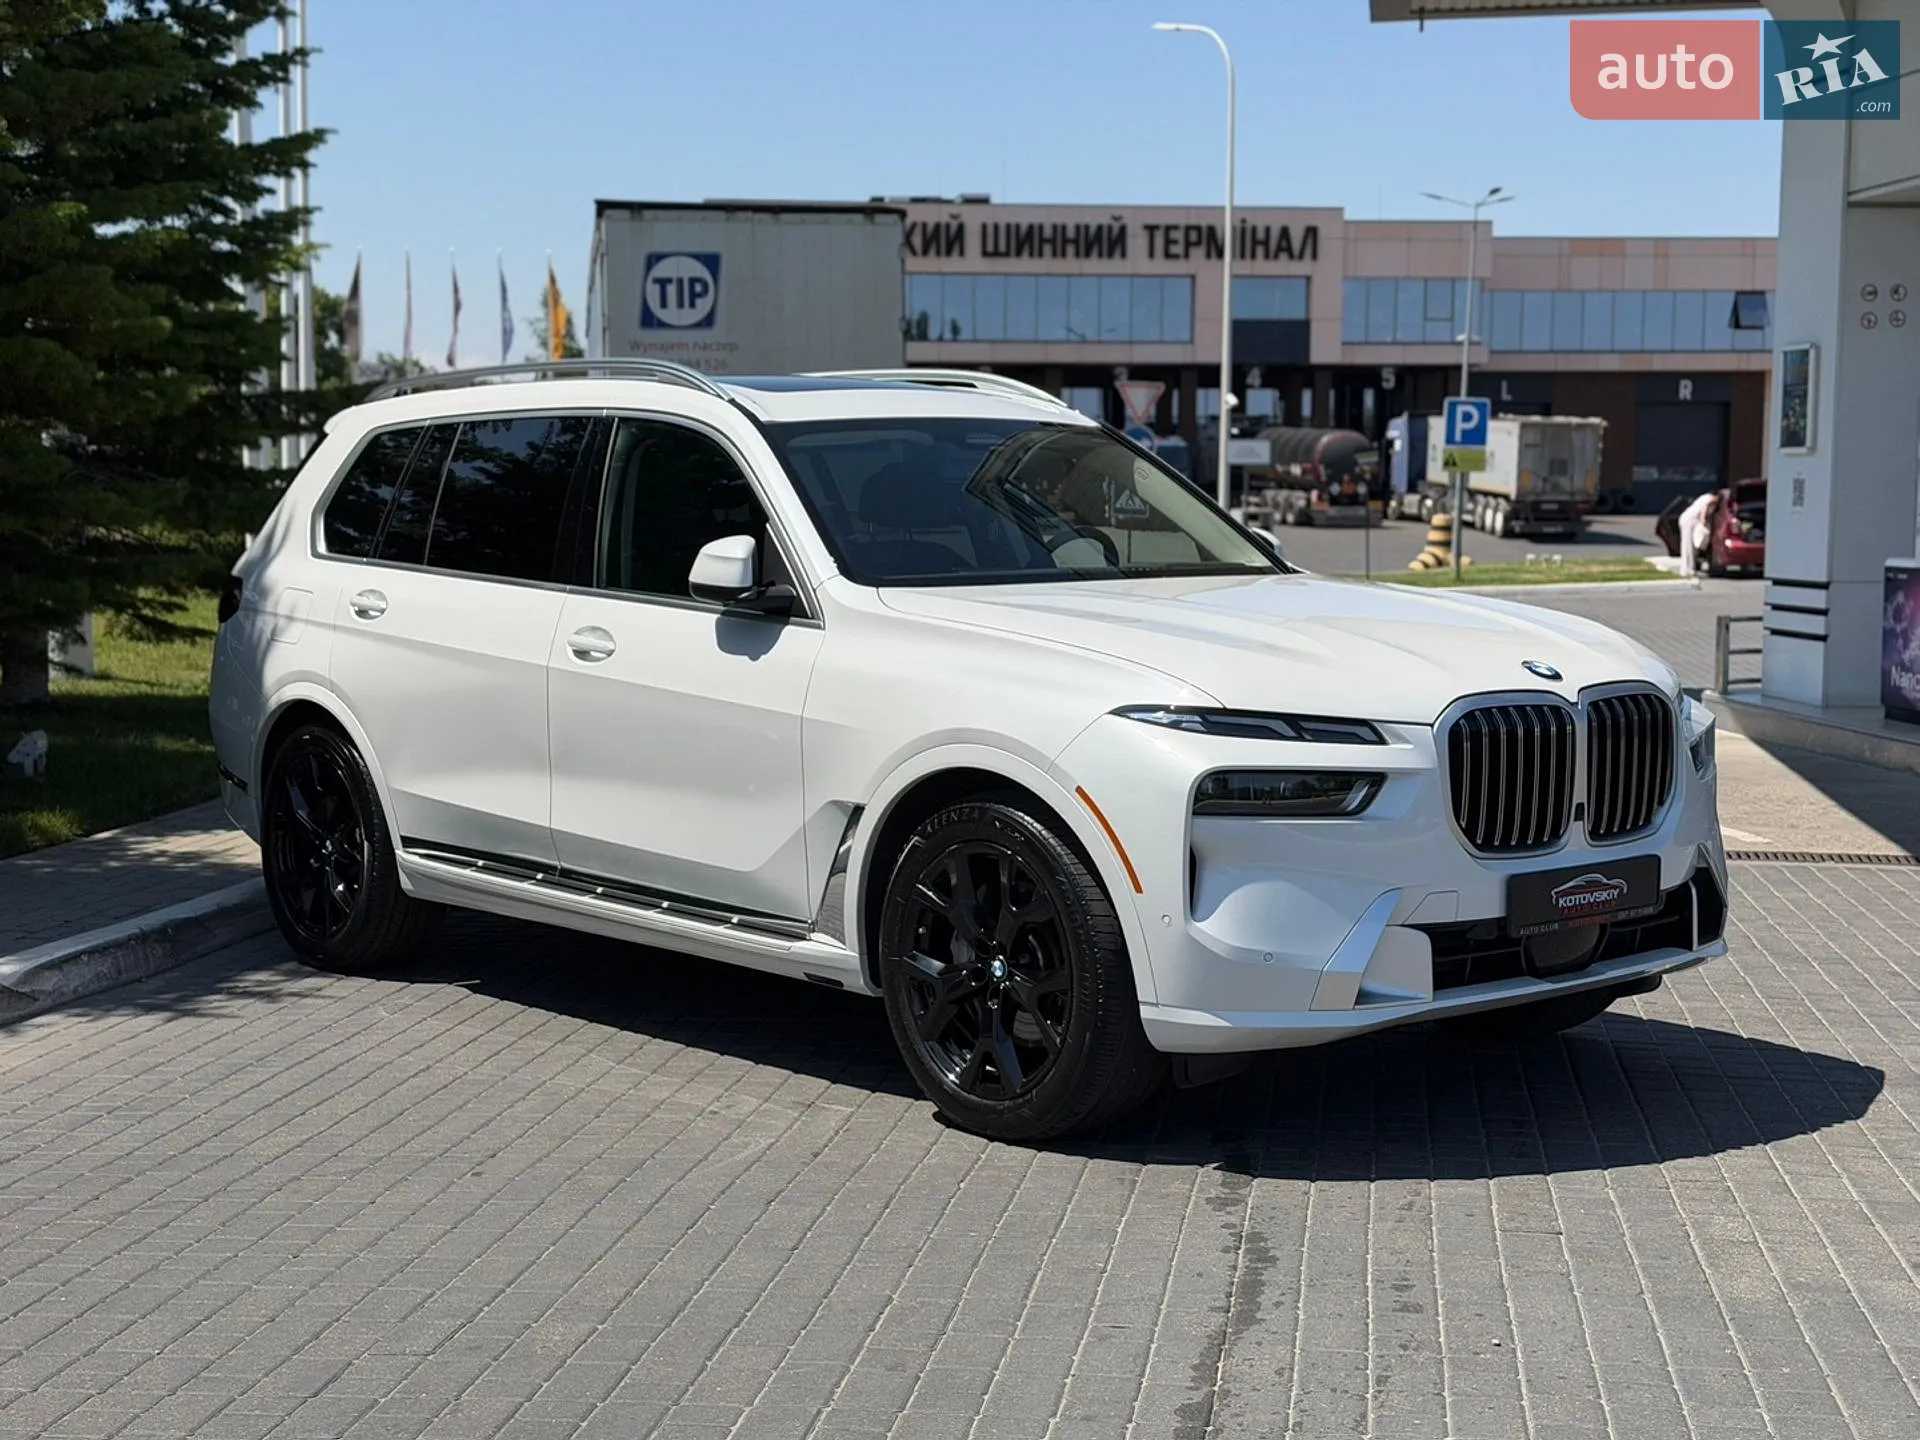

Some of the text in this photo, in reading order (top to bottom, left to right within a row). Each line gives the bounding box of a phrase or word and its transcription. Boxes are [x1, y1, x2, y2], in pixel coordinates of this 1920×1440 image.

[981, 215, 1128, 259] ШИННИЙ
[1143, 218, 1319, 261] ТЕРМІНАЛ
[652, 276, 709, 310] TIP
[628, 339, 739, 354] Wynajem naczep
[1247, 366, 1262, 388] 4
[1380, 367, 1396, 390] 5
[1501, 379, 1513, 401] L
[1678, 378, 1693, 401] R
[1454, 404, 1480, 443] P
[1558, 888, 1620, 908] KOTOVSKIY
[1519, 925, 1540, 936] AUTO
[1540, 921, 1560, 933] CLUB
